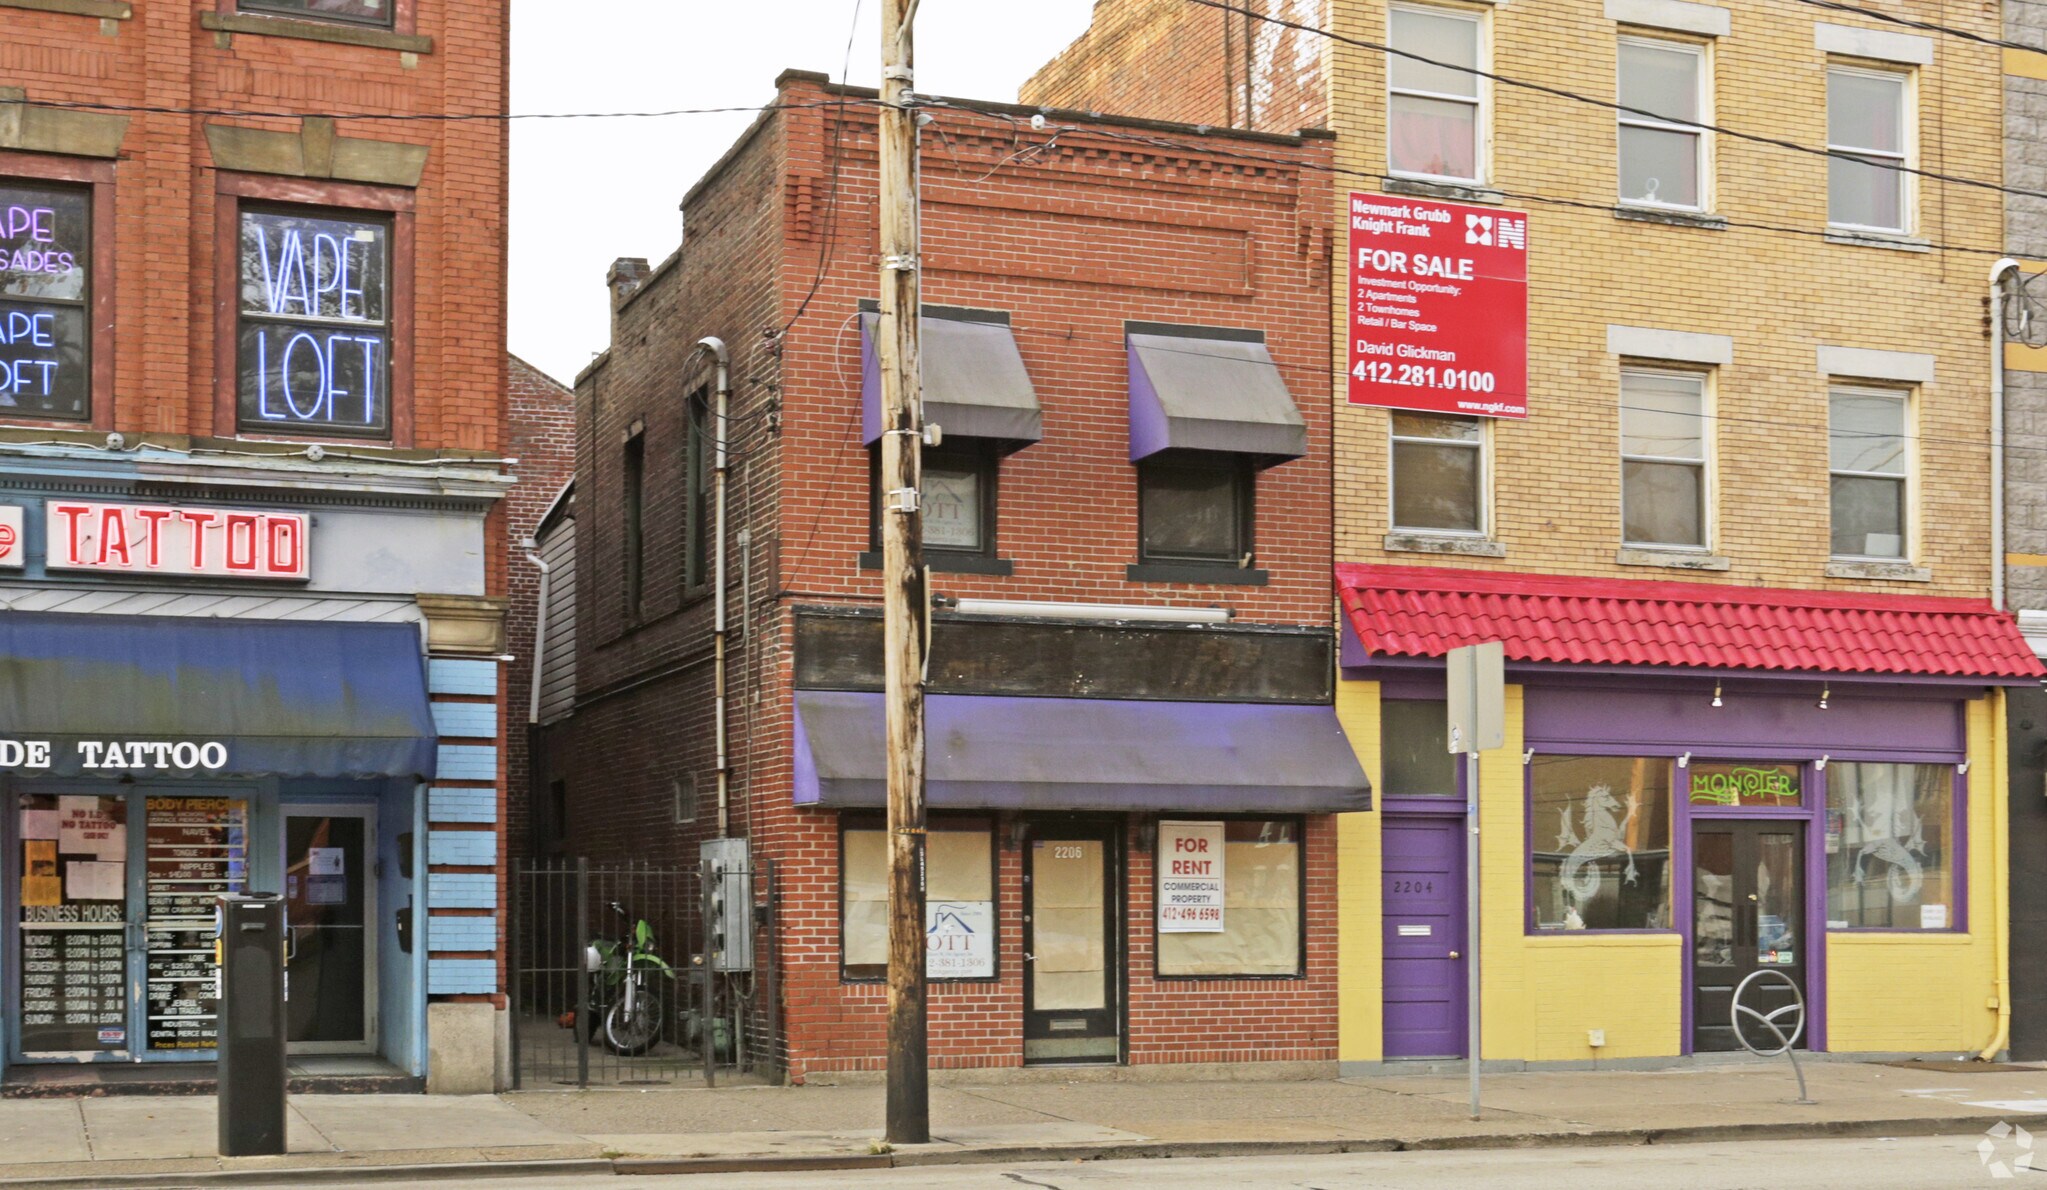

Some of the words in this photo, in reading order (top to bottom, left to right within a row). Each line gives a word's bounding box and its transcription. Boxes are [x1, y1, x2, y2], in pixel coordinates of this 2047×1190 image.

[1352, 199, 1411, 219] Newmark
[1413, 206, 1451, 223] Grubb
[1352, 216, 1394, 235] Knight
[1396, 222, 1431, 237] Frank
[1358, 247, 1408, 274] FOR
[1412, 253, 1474, 281] SALE
[257, 227, 366, 320] VAPE
[1357, 275, 1407, 289] Investment
[1408, 280, 1462, 297] Opportunity:
[1357, 288, 1364, 298] 2
[1365, 289, 1417, 304] Apartments
[1357, 302, 1364, 311] 2
[1366, 302, 1421, 317] Townhomes
[1357, 315, 1384, 327] Retail
[1390, 319, 1407, 329] Bar
[1408, 320, 1438, 332] Space
[1356, 339, 1394, 356] David
[1396, 343, 1456, 362] Glickman
[258, 330, 381, 424] LOFT
[1352, 360, 1495, 392] 412.281.0100
[1457, 401, 1525, 414] www.ngkf.com
[54, 502, 303, 575] TATTOO
[78, 741, 228, 770] TATTOO
[1690, 767, 1798, 802] MONSTER
[146, 799, 184, 810] BODY
[71, 809, 86, 818] NO
[61, 820, 76, 829] NO
[78, 820, 117, 830] TATTOO
[182, 828, 211, 836] NAVEL
[173, 849, 198, 857] TONGUE
[1054, 846, 1082, 859] 2206
[1175, 837, 1209, 853] FOR
[180, 863, 216, 871] NIPPLES
[1172, 860, 1212, 875] RENT
[1163, 882, 1219, 891] COMMERCIAL
[1394, 881, 1433, 893] 2204
[1171, 895, 1212, 903] PROPERTY
[25, 904, 79, 922] BUSINESS
[82, 904, 122, 922] HOURS:
[926, 934, 975, 951] OTT
